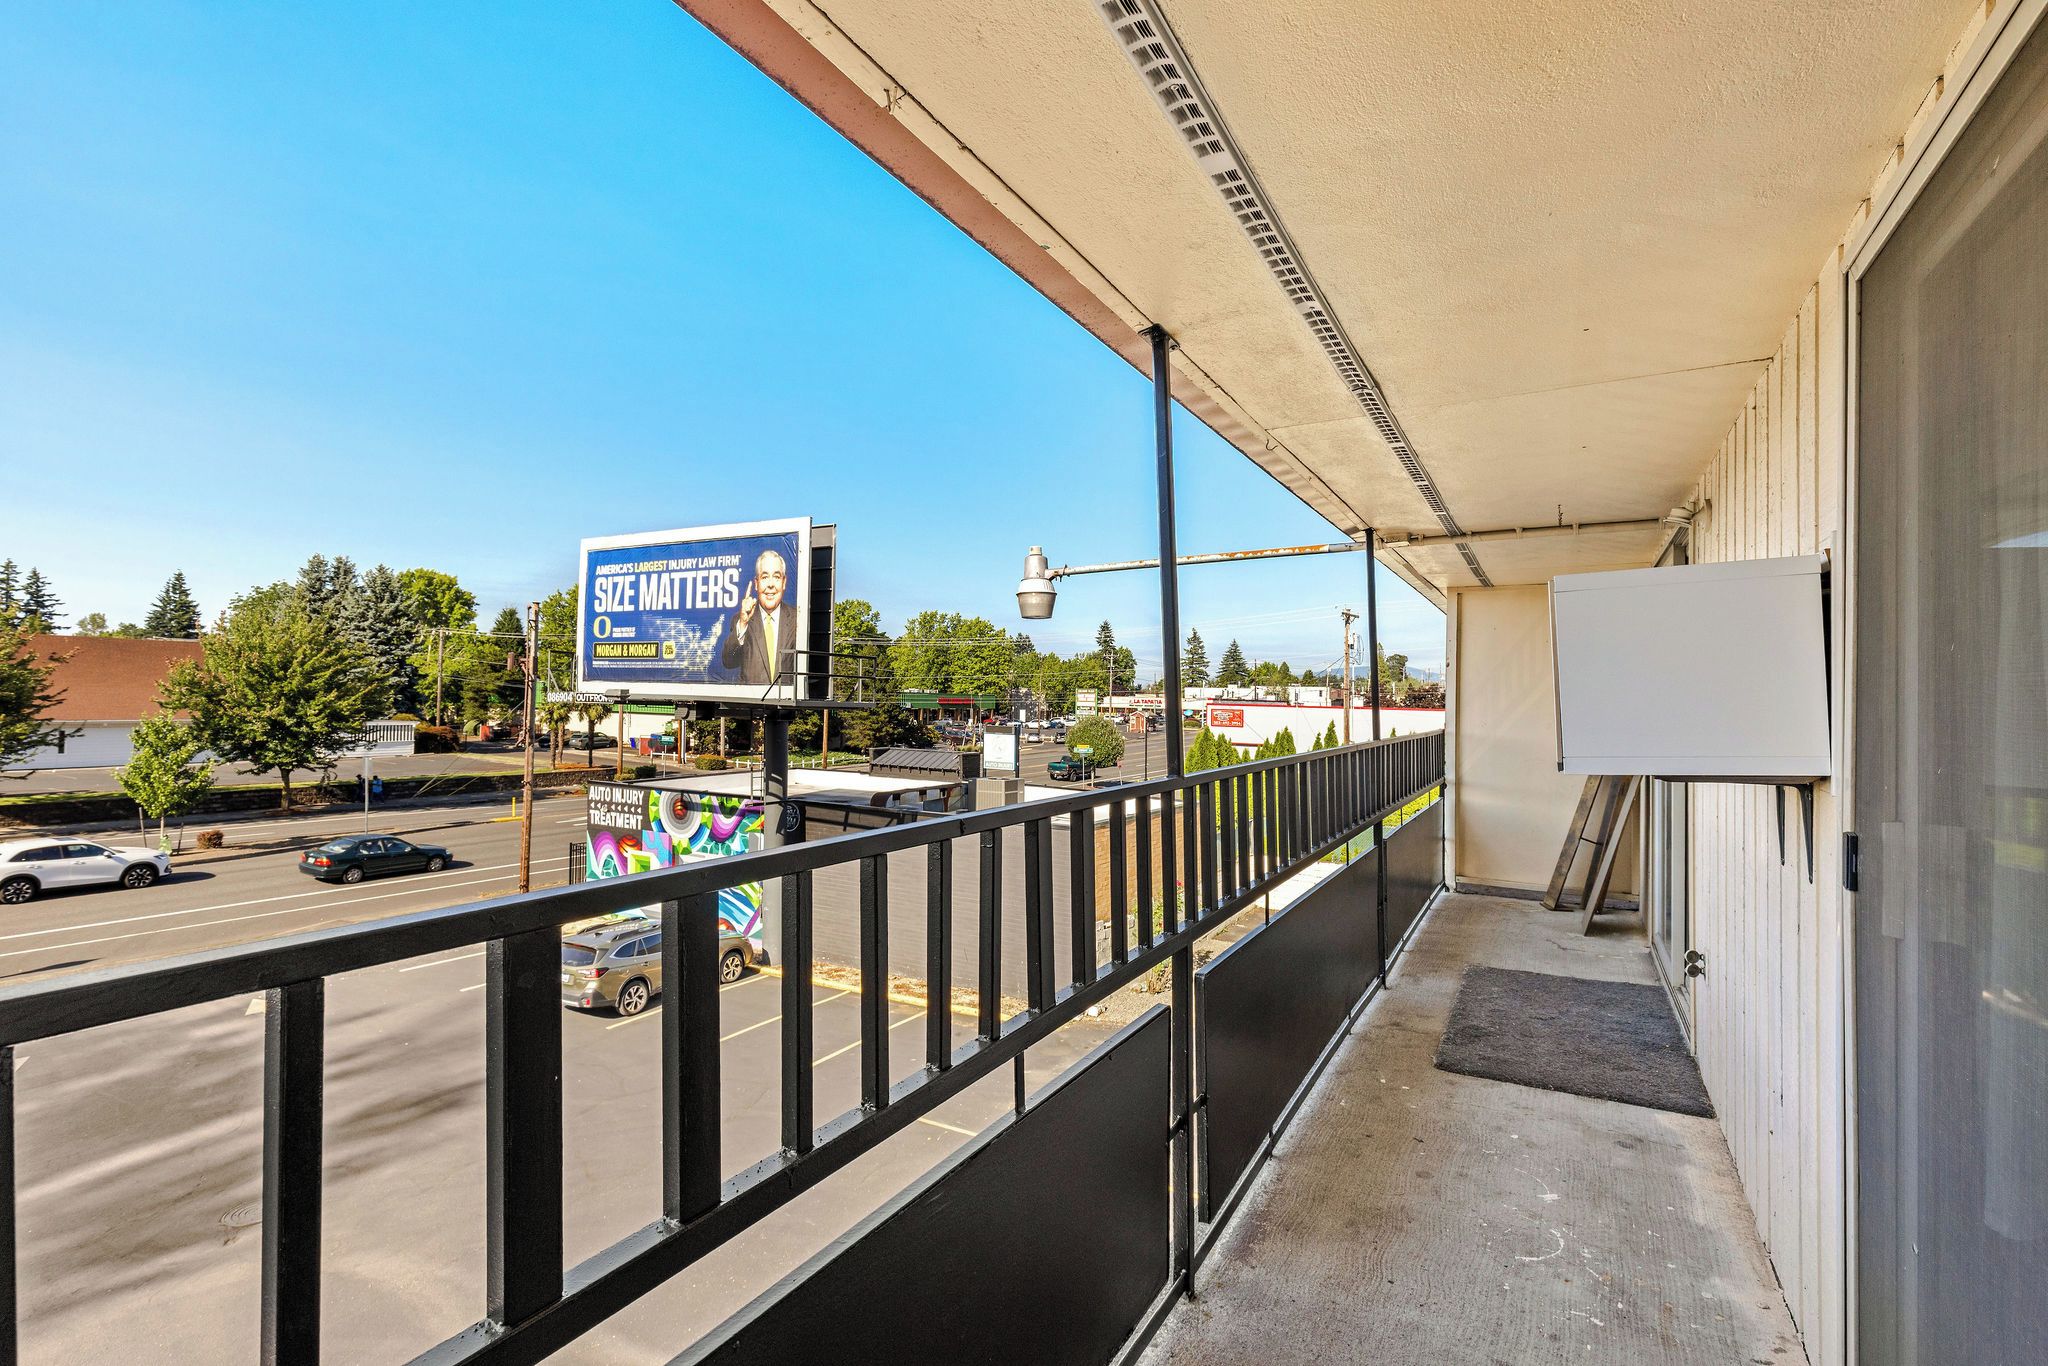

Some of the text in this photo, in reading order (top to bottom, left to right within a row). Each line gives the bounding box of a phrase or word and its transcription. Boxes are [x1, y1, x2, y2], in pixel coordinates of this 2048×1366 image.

[595, 562, 634, 575] AMERICA'S
[634, 560, 668, 572] LARGEST
[668, 557, 698, 571] INJURY
[698, 556, 717, 569] LAW
[594, 568, 740, 613] SIZE MATTERS
[596, 644, 622, 657] MORGAN
[622, 644, 628, 657] &
[628, 643, 656, 657] MORGAN
[547, 691, 573, 703] 086904
[576, 693, 612, 703] OUTFRON
[589, 785, 645, 806] AUTO INJURY
[589, 809, 643, 831] TREATMENT
